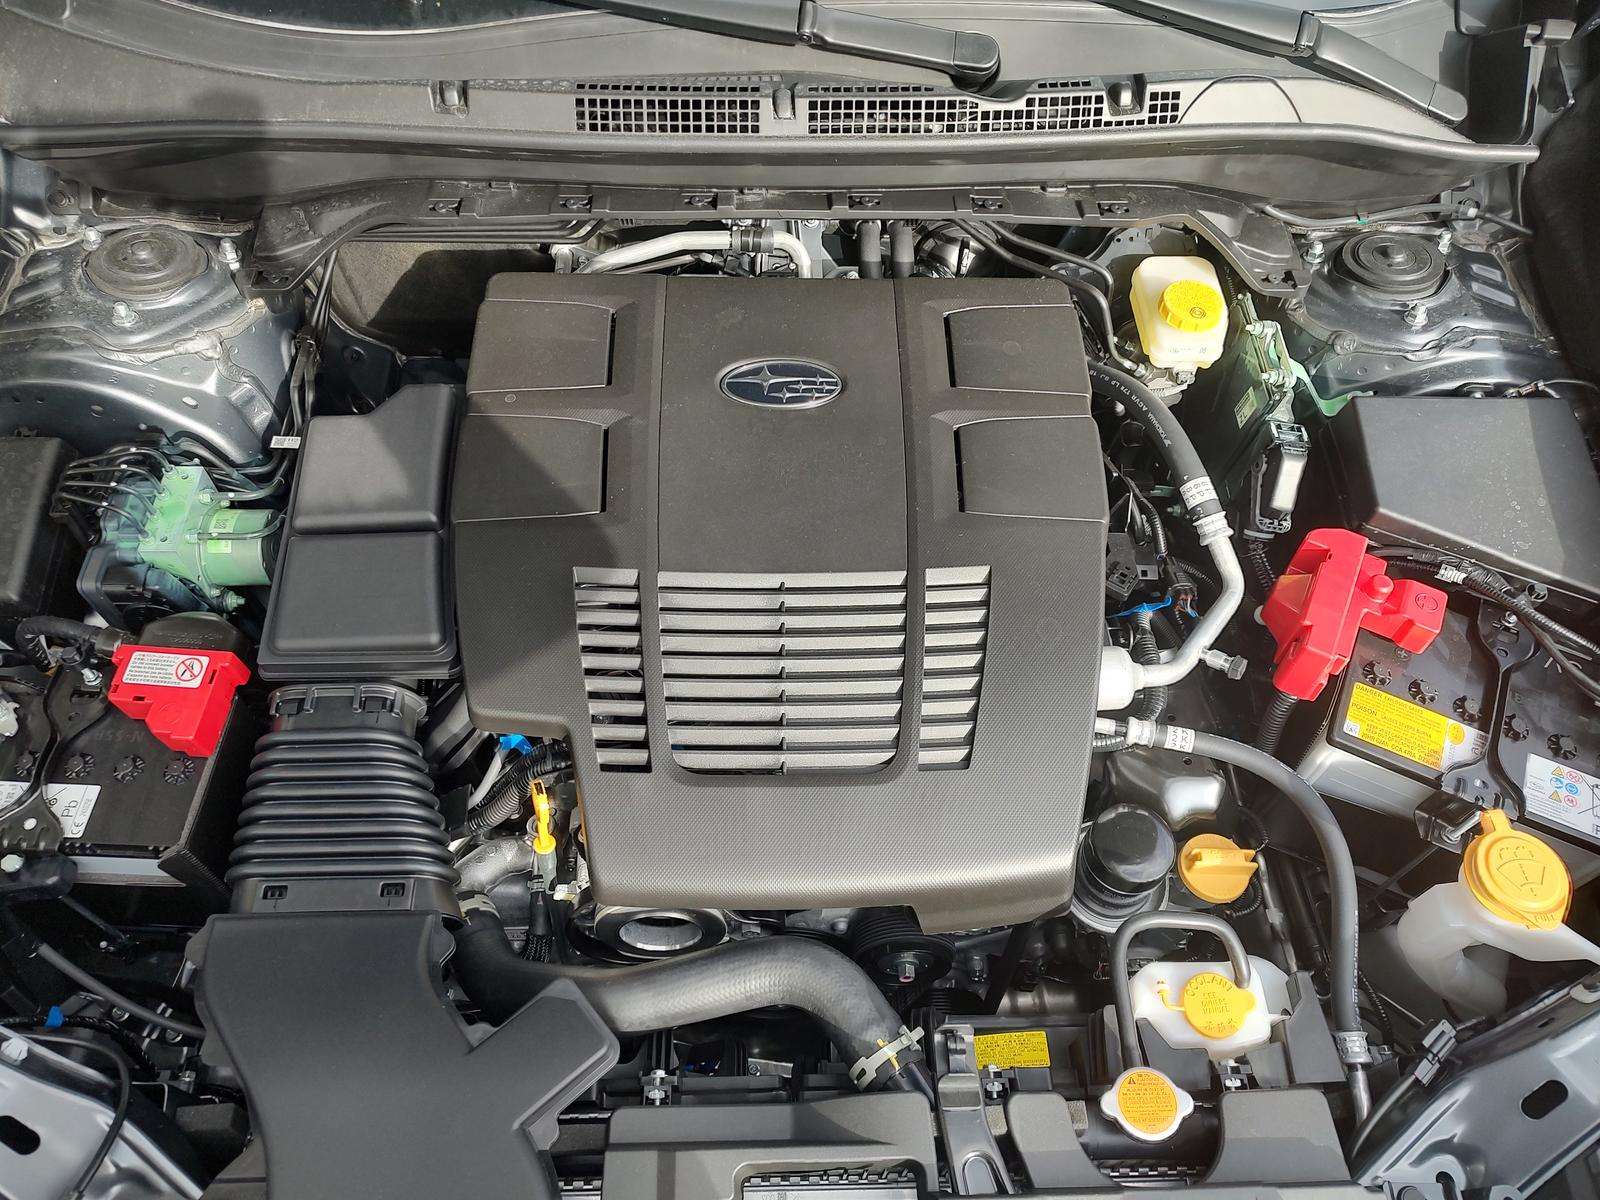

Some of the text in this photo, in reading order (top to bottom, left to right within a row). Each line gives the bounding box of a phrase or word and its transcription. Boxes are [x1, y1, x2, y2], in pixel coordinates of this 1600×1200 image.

[1355, 684, 1383, 698] DANGER
[1351, 702, 1377, 716] POISON
[61, 800, 79, 818] Pb
[1185, 975, 1233, 997] COOLANT
